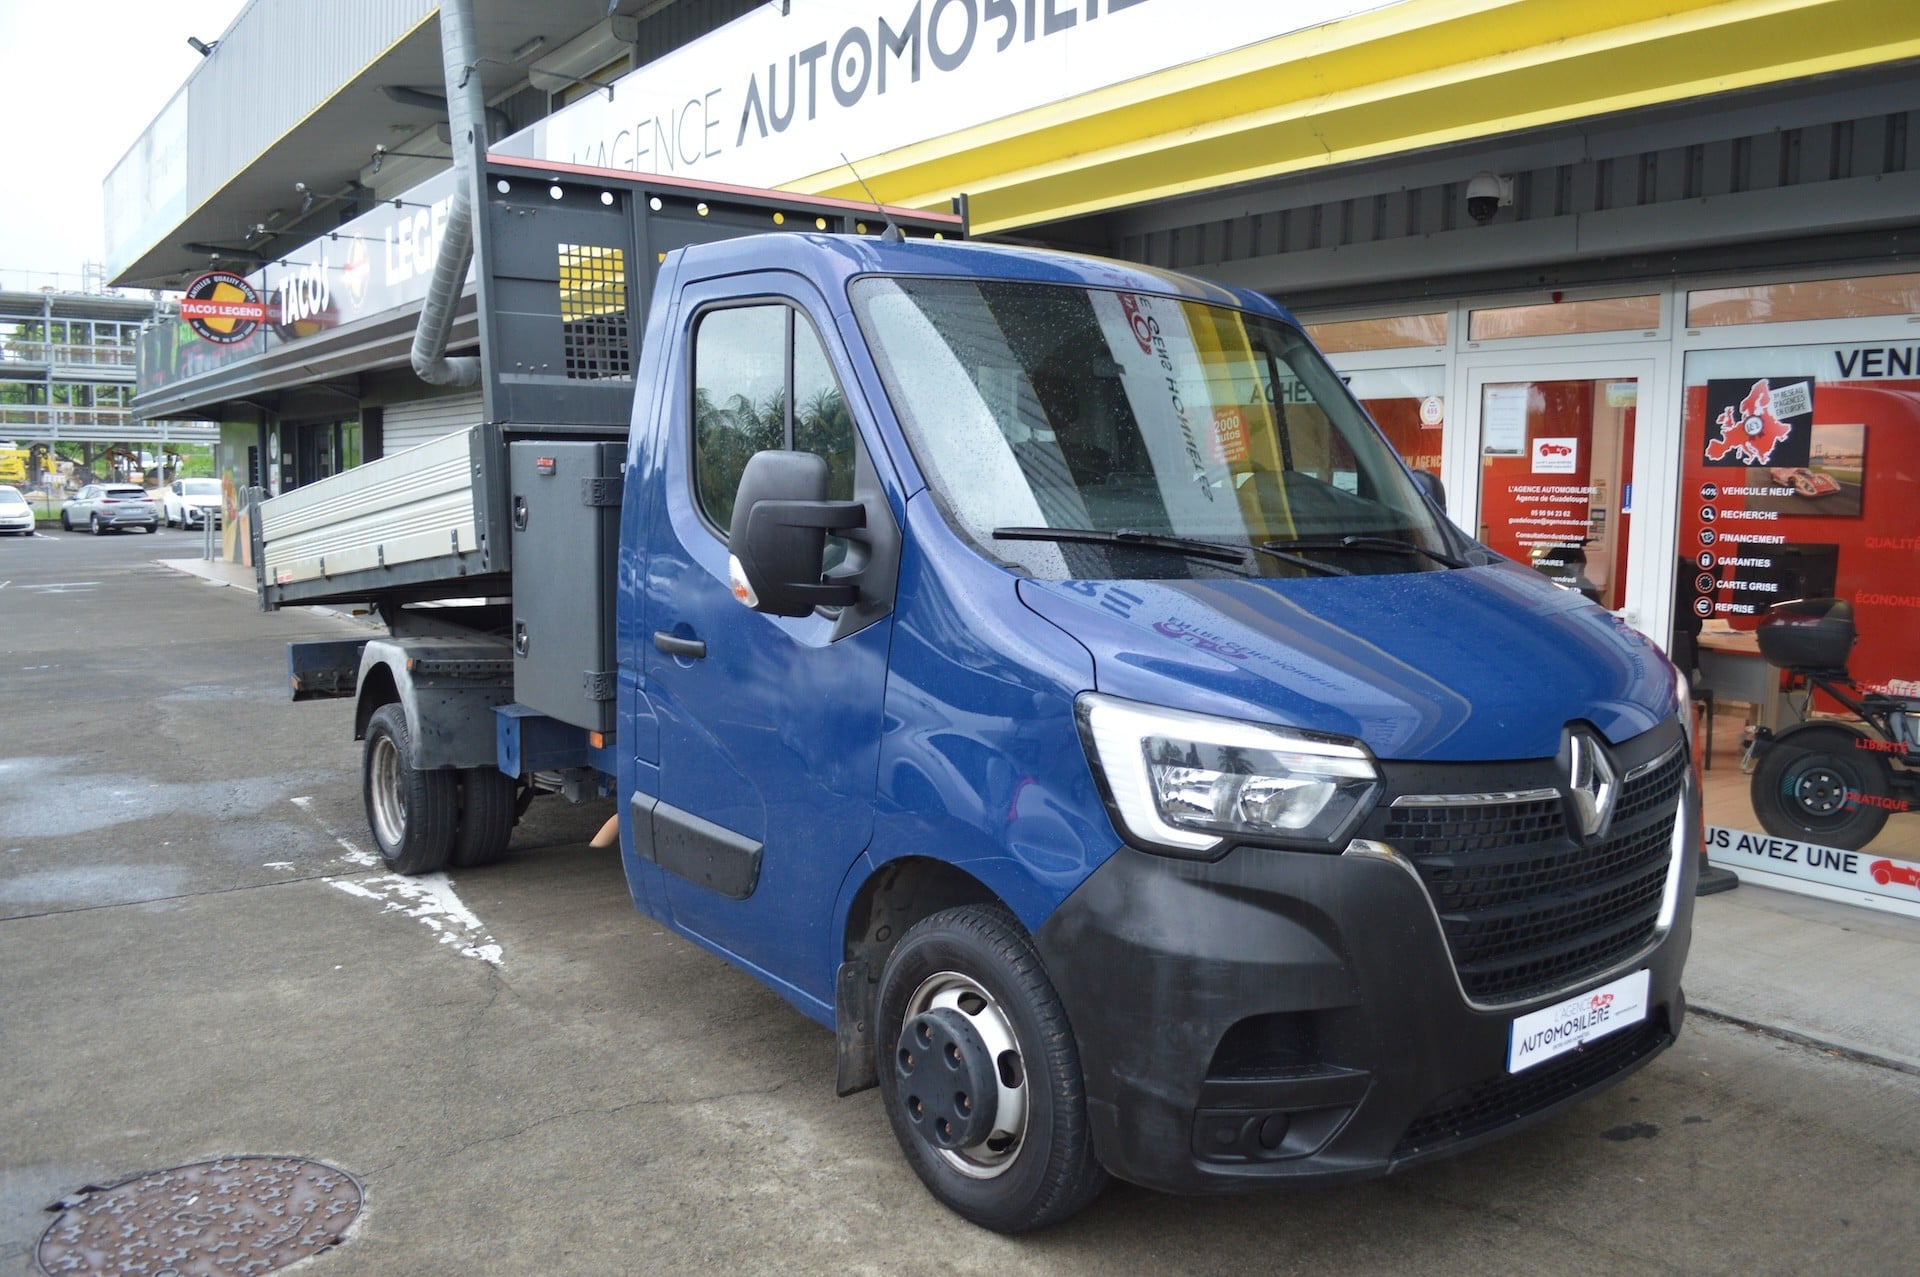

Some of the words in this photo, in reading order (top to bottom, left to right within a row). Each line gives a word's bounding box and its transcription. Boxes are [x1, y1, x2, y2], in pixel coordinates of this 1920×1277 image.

[279, 257, 330, 326] TACOS
[385, 194, 455, 287] LEGE
[213, 275, 240, 286] QUALITY
[181, 303, 217, 315] TACOS
[219, 306, 263, 317] LEGEND
[1834, 346, 1920, 378] VEN
[1784, 402, 1806, 413] EUROPE
[1215, 416, 1239, 433] 2000
[1722, 487, 1768, 496] VEHICULE
[1769, 488, 1795, 497] NEUF
[1515, 494, 1539, 504] Agence
[1549, 495, 1588, 504] Guadeloupe
[1721, 510, 1778, 520] RECHERCHE
[1719, 533, 1785, 545] FINANCEMENT
[1532, 559, 1565, 567] HORAIRES
[1718, 557, 1771, 568] GARANTIES
[1716, 580, 1747, 590] CARTE
[1748, 582, 1778, 592] GRISE
[1715, 603, 1755, 613] REPRISE
[1736, 834, 1798, 863] AVEZ
[1806, 846, 1858, 874] UNE
